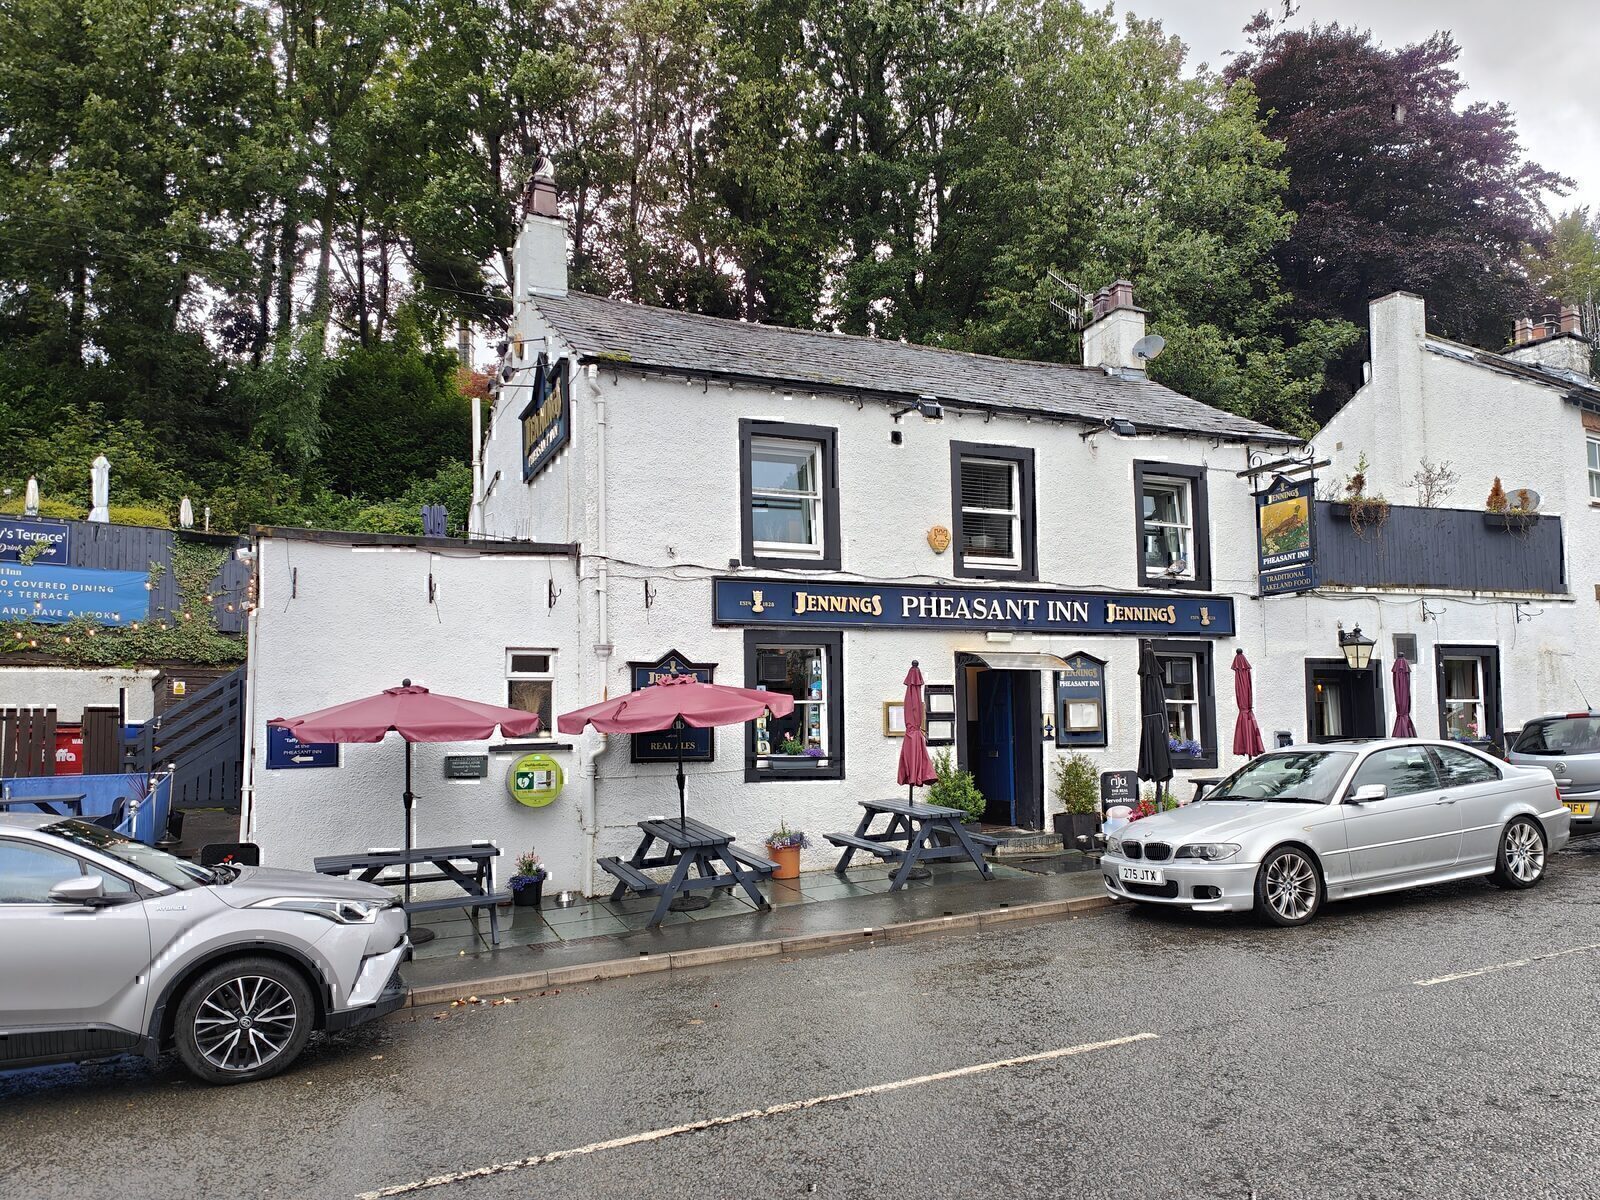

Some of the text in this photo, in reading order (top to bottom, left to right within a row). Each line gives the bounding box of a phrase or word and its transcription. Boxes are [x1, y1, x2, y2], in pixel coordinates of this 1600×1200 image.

[1268, 488, 1299, 504] JENNINGS
[15, 528, 66, 543] Terrace'
[1263, 550, 1310, 565] PHEASANT INN
[6, 568, 22, 576] Inn
[1266, 570, 1305, 583] TRADITIONAL
[14, 580, 67, 590] COVERED
[72, 580, 114, 593] DINING
[1261, 578, 1311, 592] LAKELAND FOOD
[19, 590, 70, 600] TERRACE
[795, 591, 883, 616] JENNINGS
[901, 595, 1089, 623] PHEASANT INN
[2, 607, 27, 616] AND
[33, 608, 63, 617] HAVE
[1106, 603, 1176, 624] JENNINGS
[650, 742, 672, 750] REAL
[1563, 803, 1585, 812] NFV
[1123, 868, 1156, 881] 275 JTX
